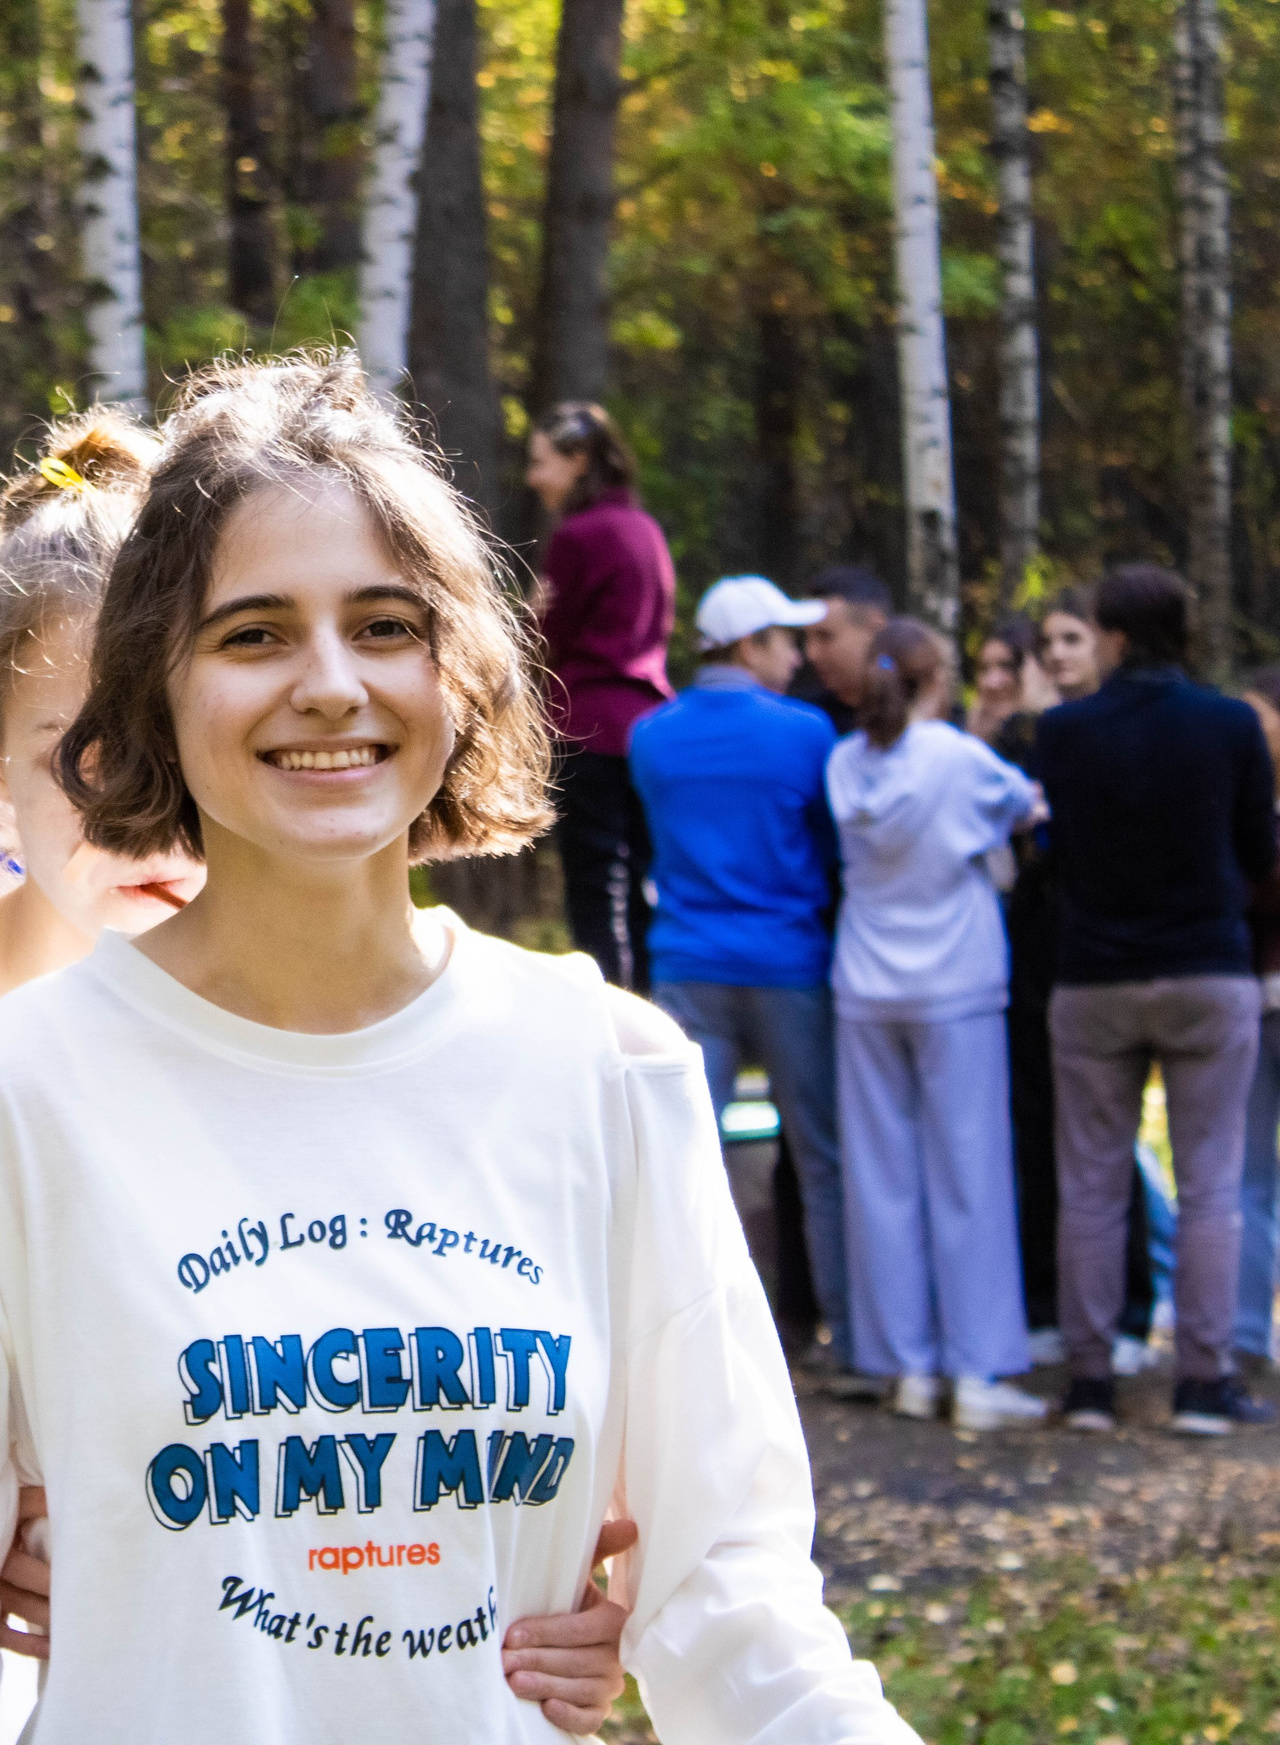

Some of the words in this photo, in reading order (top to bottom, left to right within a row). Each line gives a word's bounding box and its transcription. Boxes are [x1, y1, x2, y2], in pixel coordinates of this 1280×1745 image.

[177, 1217, 270, 1294] Daily
[279, 1212, 347, 1251] Log
[383, 1208, 545, 1285] Raptures
[177, 1326, 573, 1427] SINCERITY
[145, 1438, 261, 1532] ON
[274, 1432, 398, 1518] MY
[412, 1428, 576, 1513] MIND
[308, 1540, 441, 1576] raptures
[218, 1575, 330, 1651] What's
[334, 1615, 393, 1659] the
